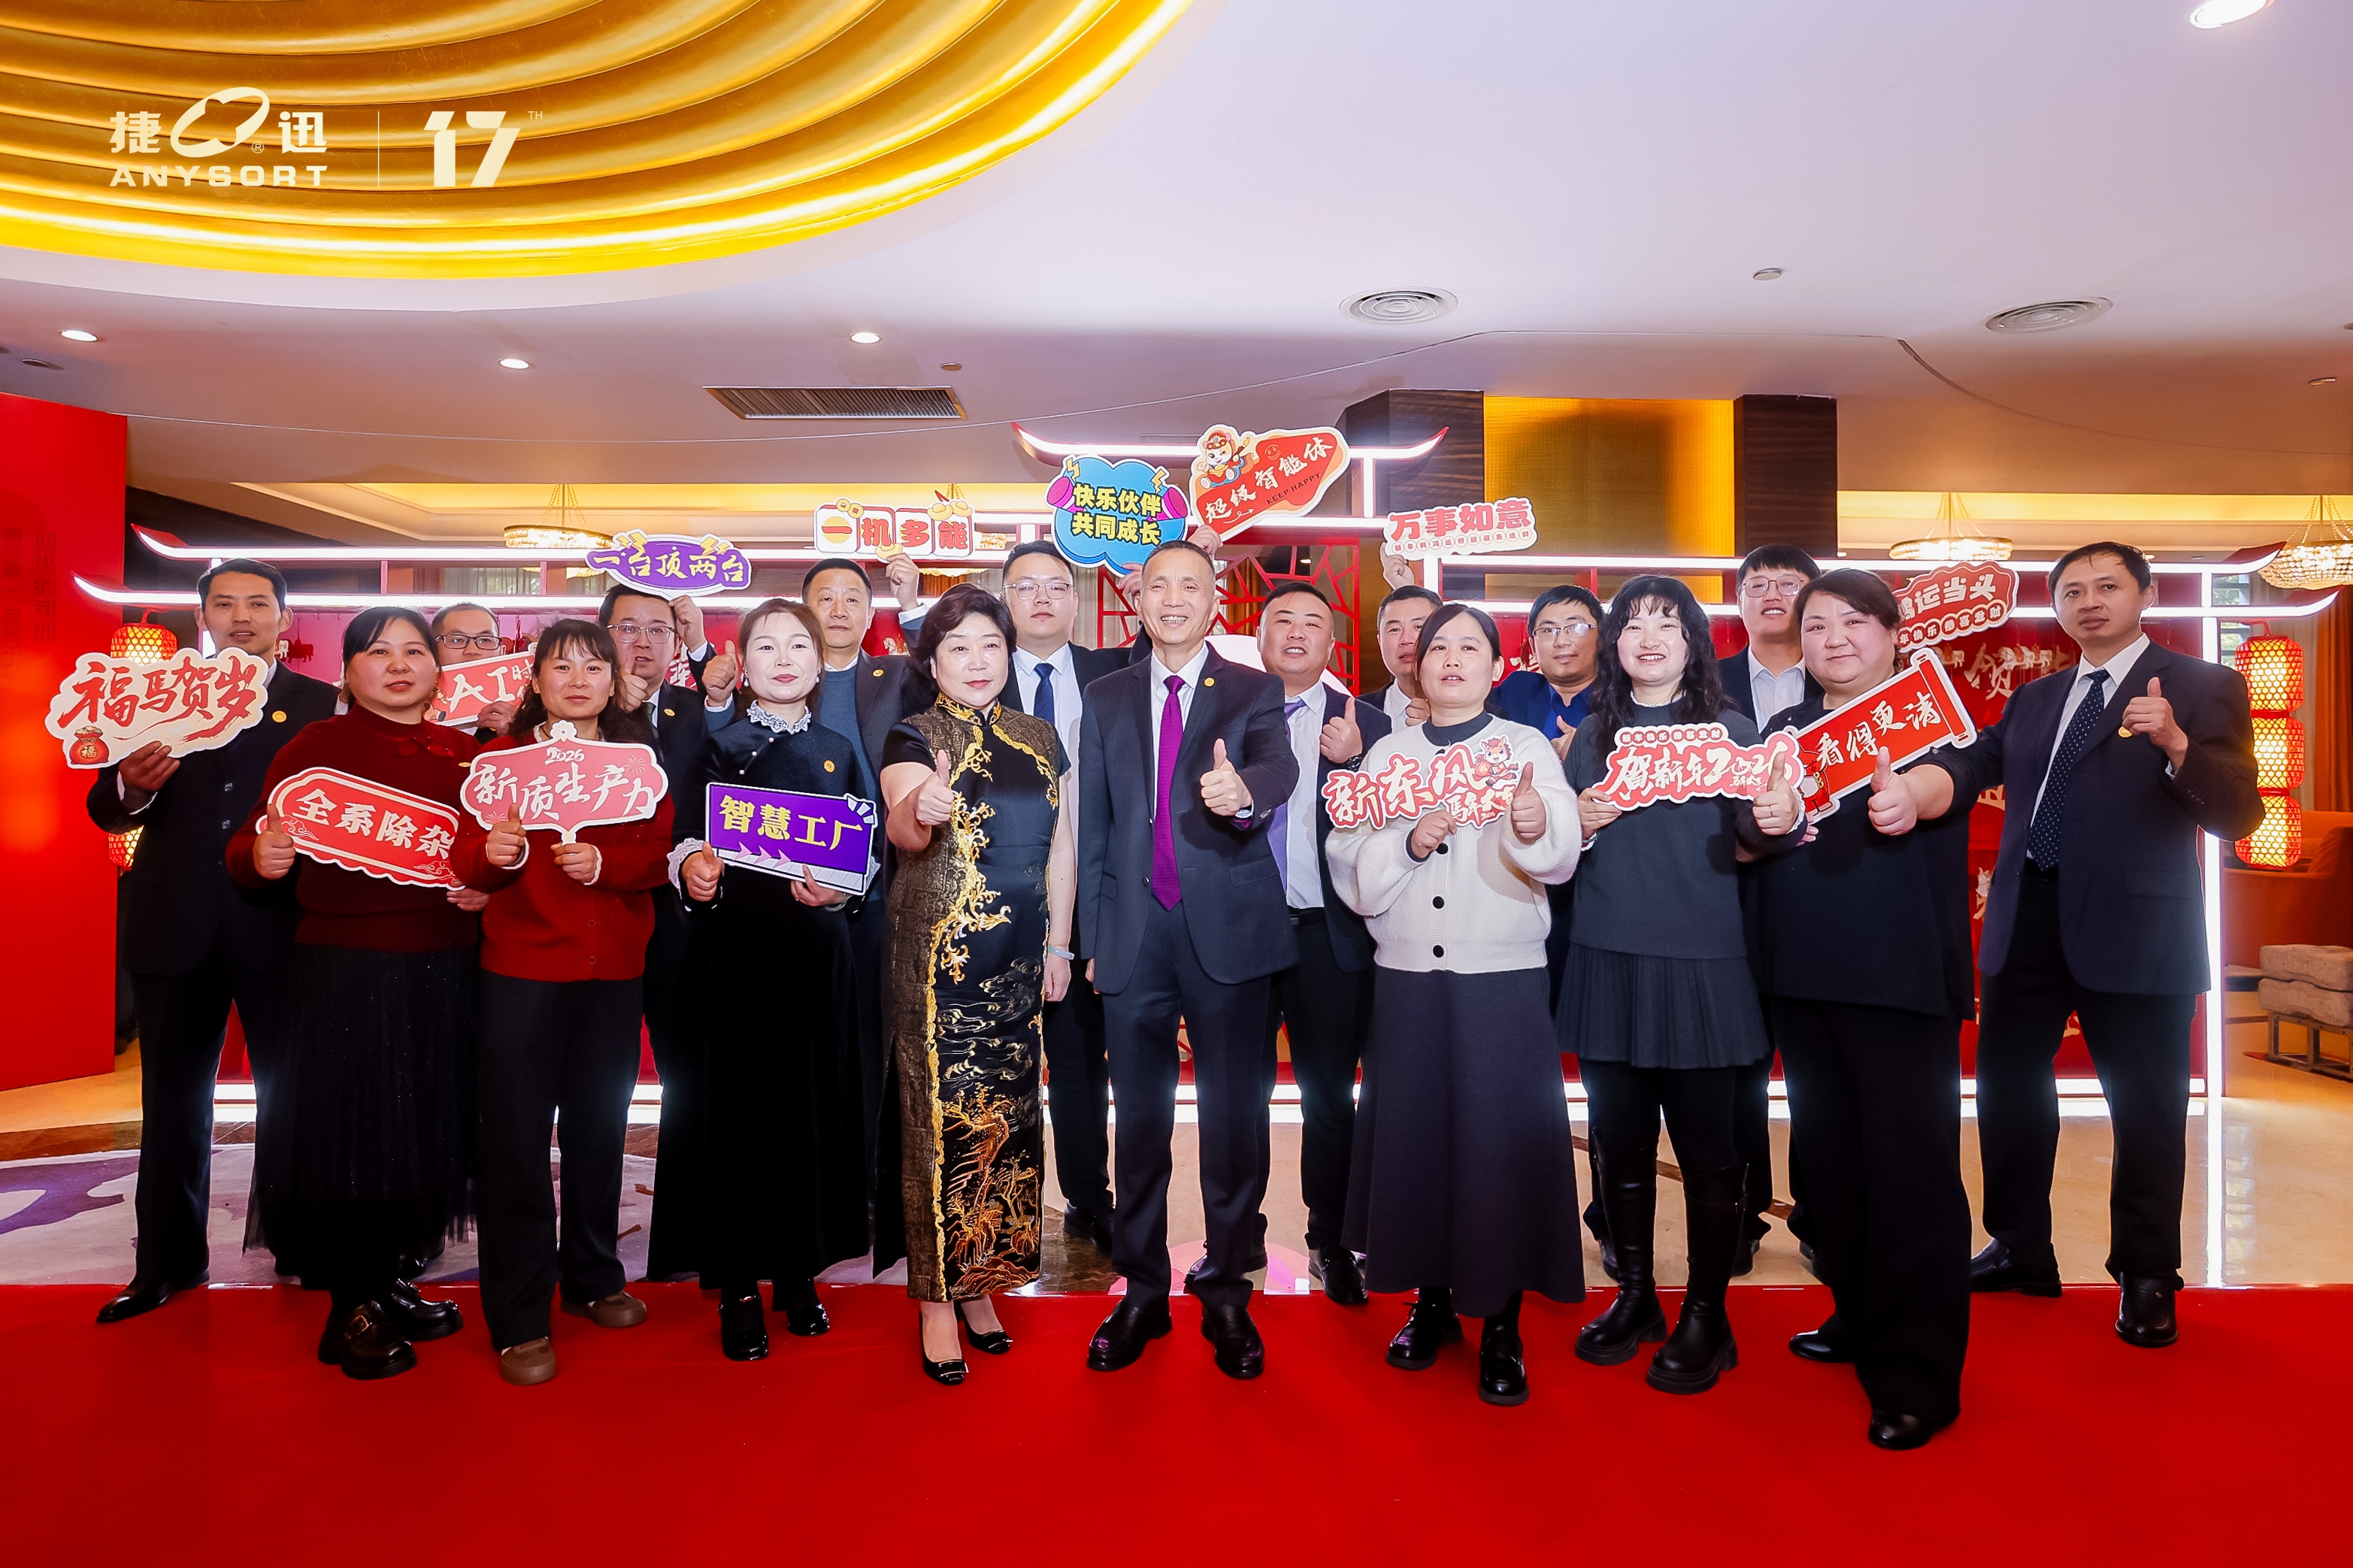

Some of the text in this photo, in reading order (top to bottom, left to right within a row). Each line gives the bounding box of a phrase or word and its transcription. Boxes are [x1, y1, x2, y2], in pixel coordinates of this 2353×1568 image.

[1205, 437, 1333, 524] 超级智能体
[1266, 472, 1321, 504] KEEP HAPPY
[1072, 482, 1163, 517] 快乐伙伴
[822, 517, 968, 549] 一机多能
[1071, 511, 1162, 546] 共同成长
[1390, 500, 1531, 541] 万事如意
[593, 546, 744, 583] 一台顶两台
[1622, 729, 1721, 743] 新年快乐 恭喜发财
[1815, 691, 1941, 770] 看得更清
[80, 746, 97, 758] 福
[544, 746, 586, 765] 2026
[473, 762, 654, 821] 新质生产力
[1327, 747, 1487, 825] 新东风
[292, 788, 456, 860] 全系除杂
[719, 795, 863, 851] 智慧工厂
